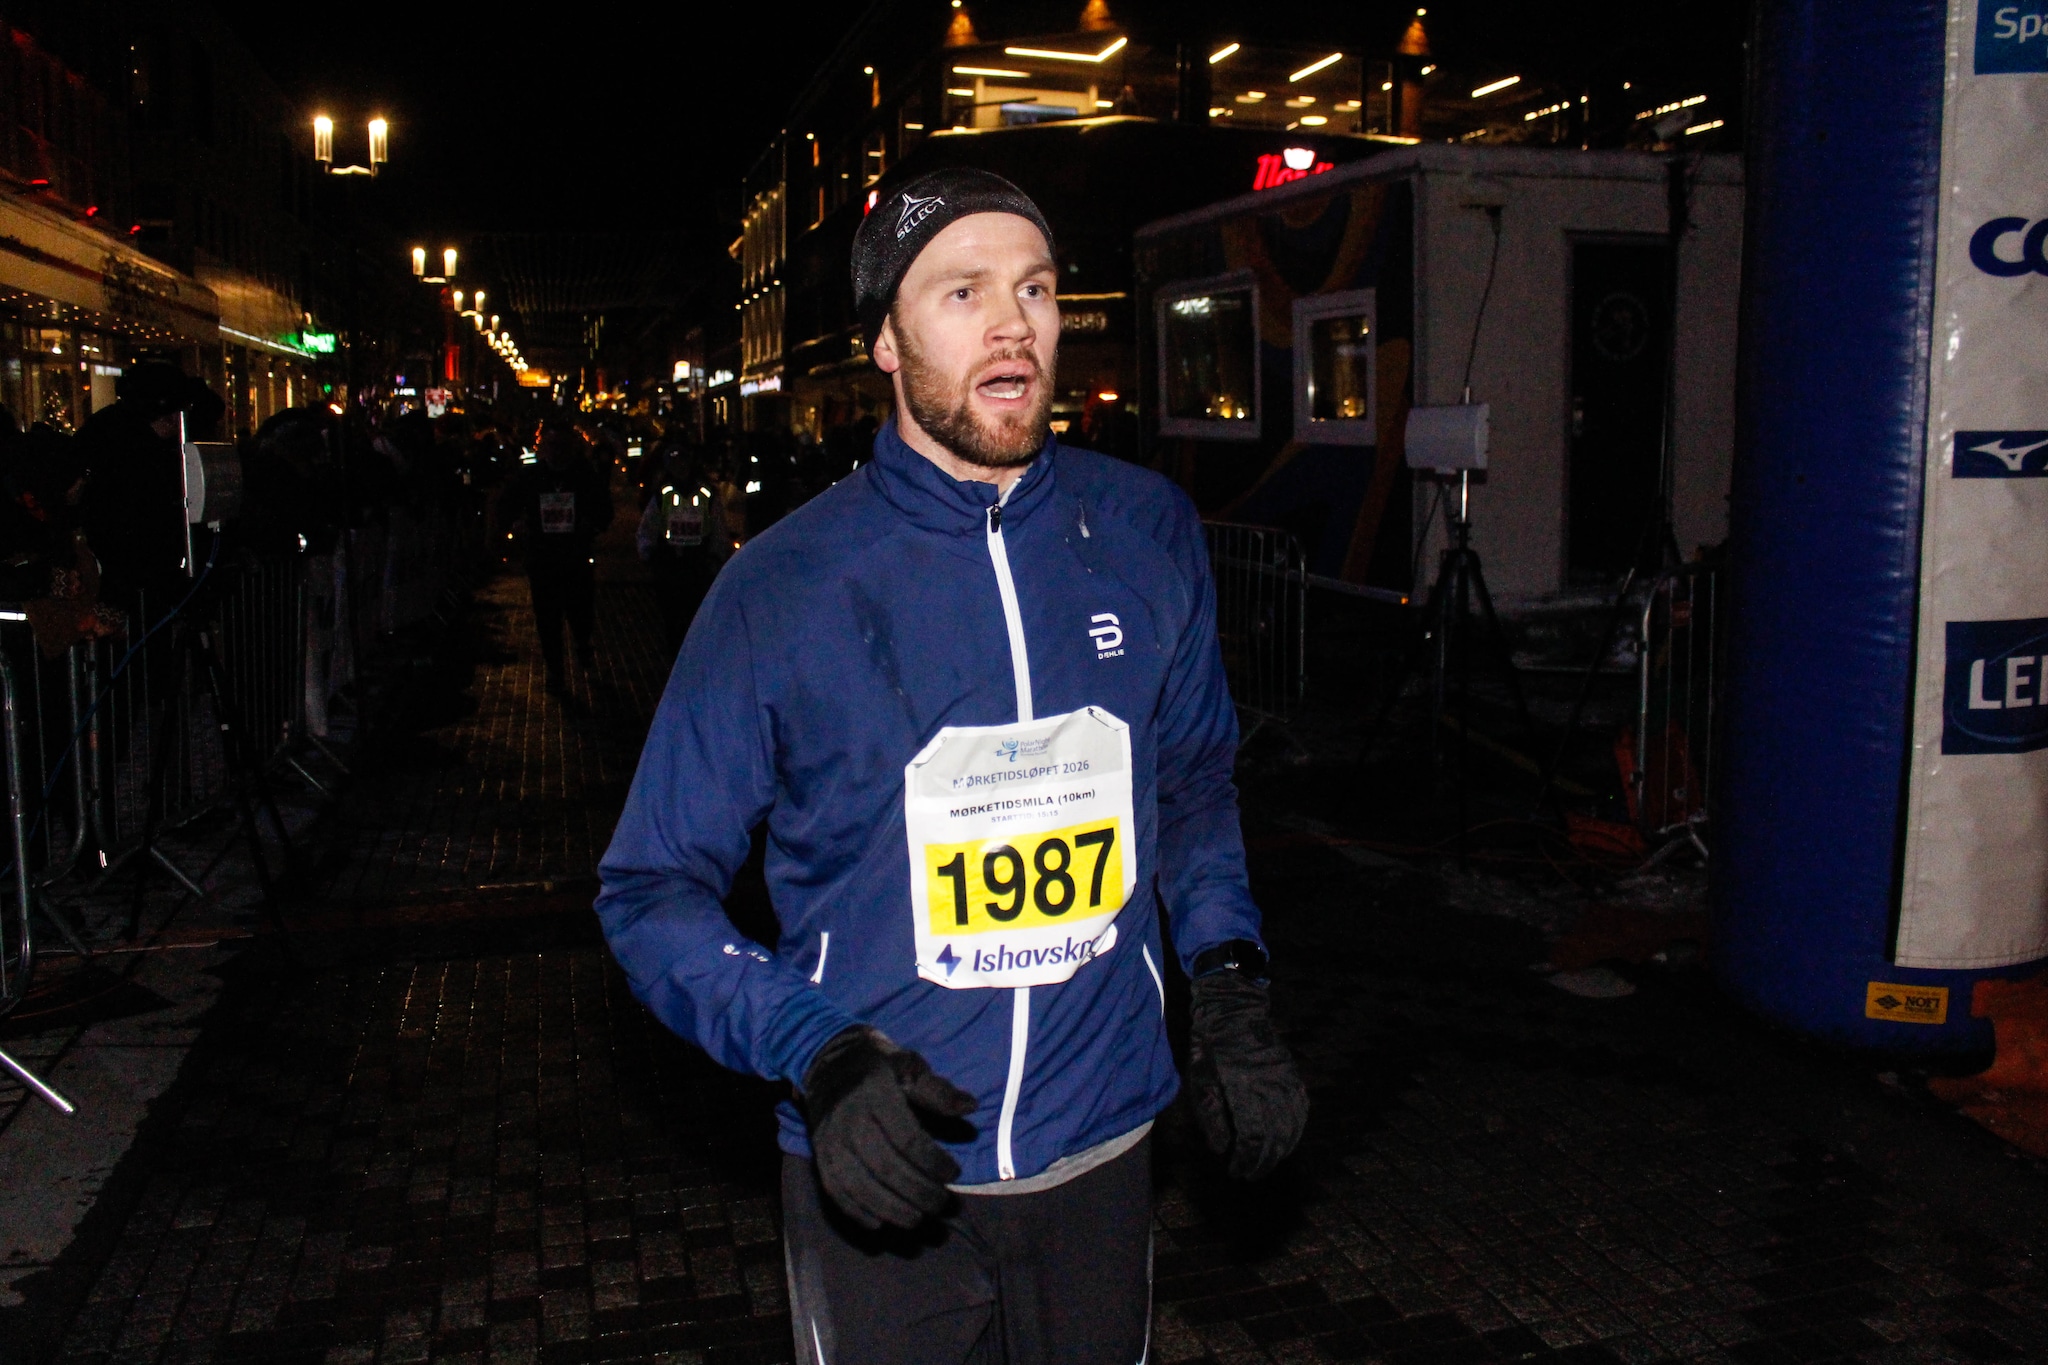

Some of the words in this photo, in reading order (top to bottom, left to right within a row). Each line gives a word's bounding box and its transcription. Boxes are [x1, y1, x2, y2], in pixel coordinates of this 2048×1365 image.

[897, 197, 945, 240] SELECT
[953, 764, 1059, 788] MØRKETIDSLØPET
[1063, 761, 1090, 774] 2026
[950, 796, 1054, 818] MØRKETIDSMILA
[1058, 788, 1096, 805] (10km)
[937, 827, 1115, 926] 1987
